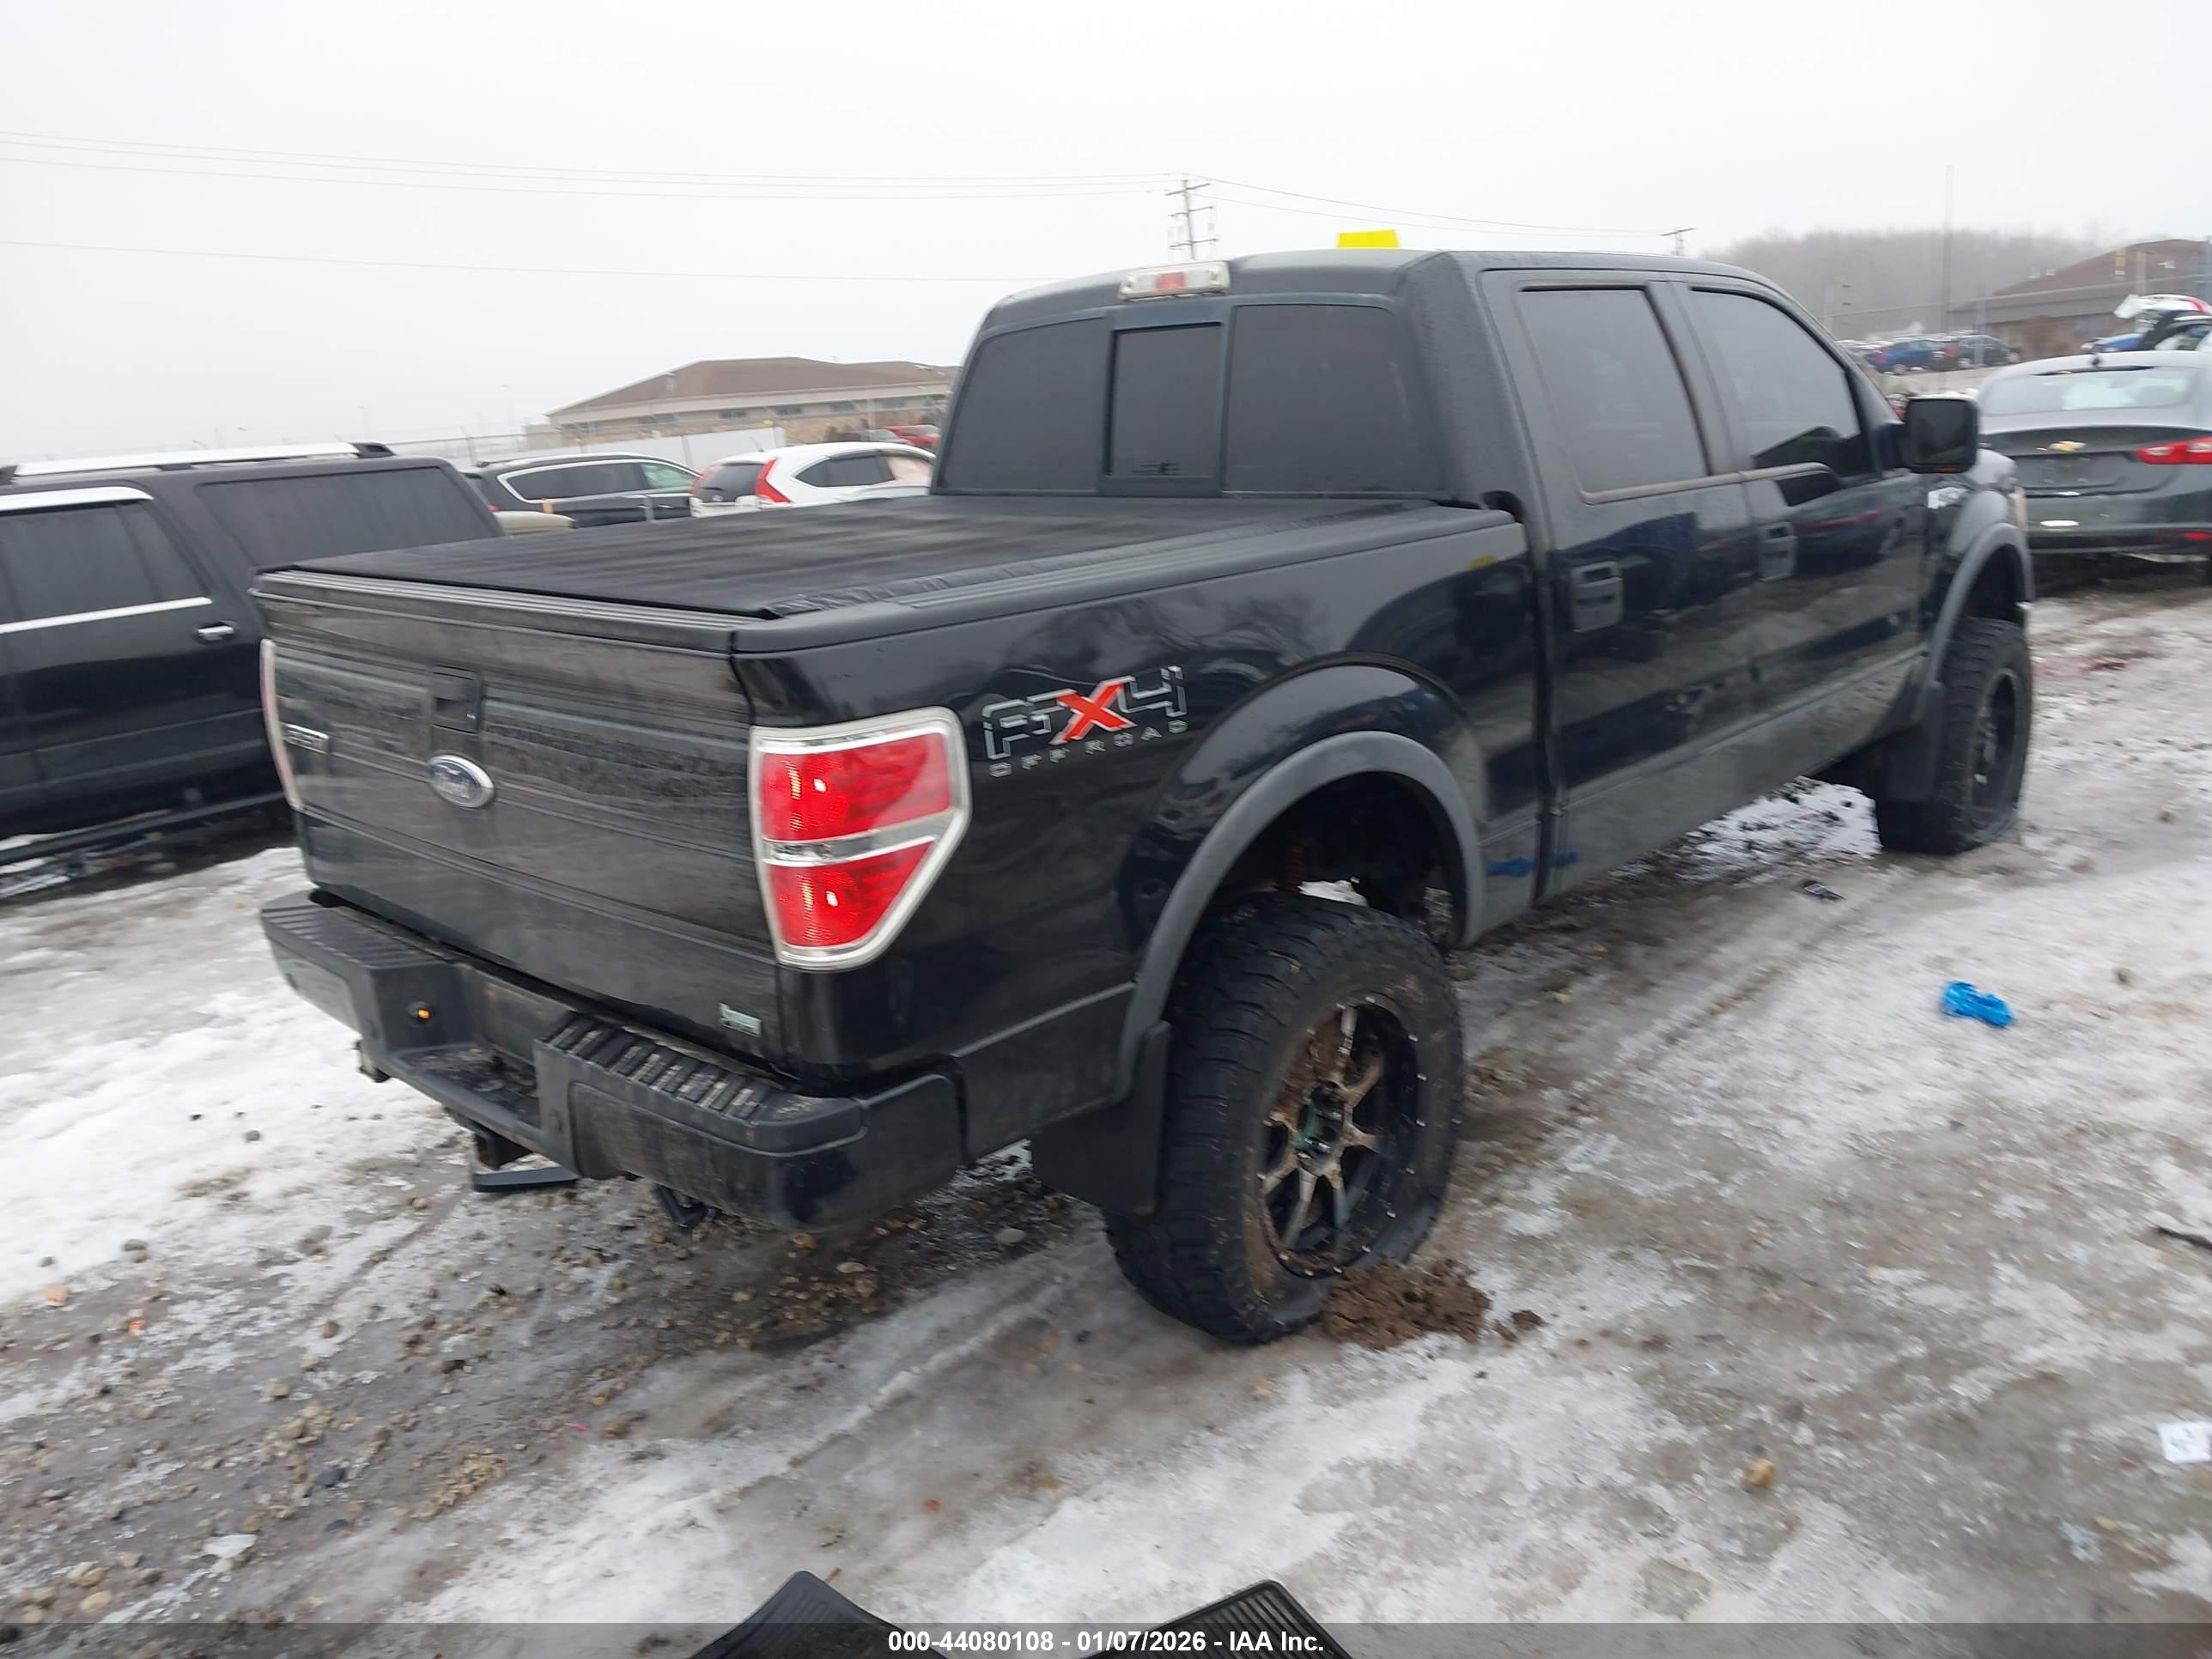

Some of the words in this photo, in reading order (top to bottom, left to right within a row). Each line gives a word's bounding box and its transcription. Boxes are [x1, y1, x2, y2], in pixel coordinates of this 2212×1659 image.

[982, 665, 1188, 761] FX4
[988, 747, 1071, 778] OFF
[1085, 720, 1189, 755] ROAD
